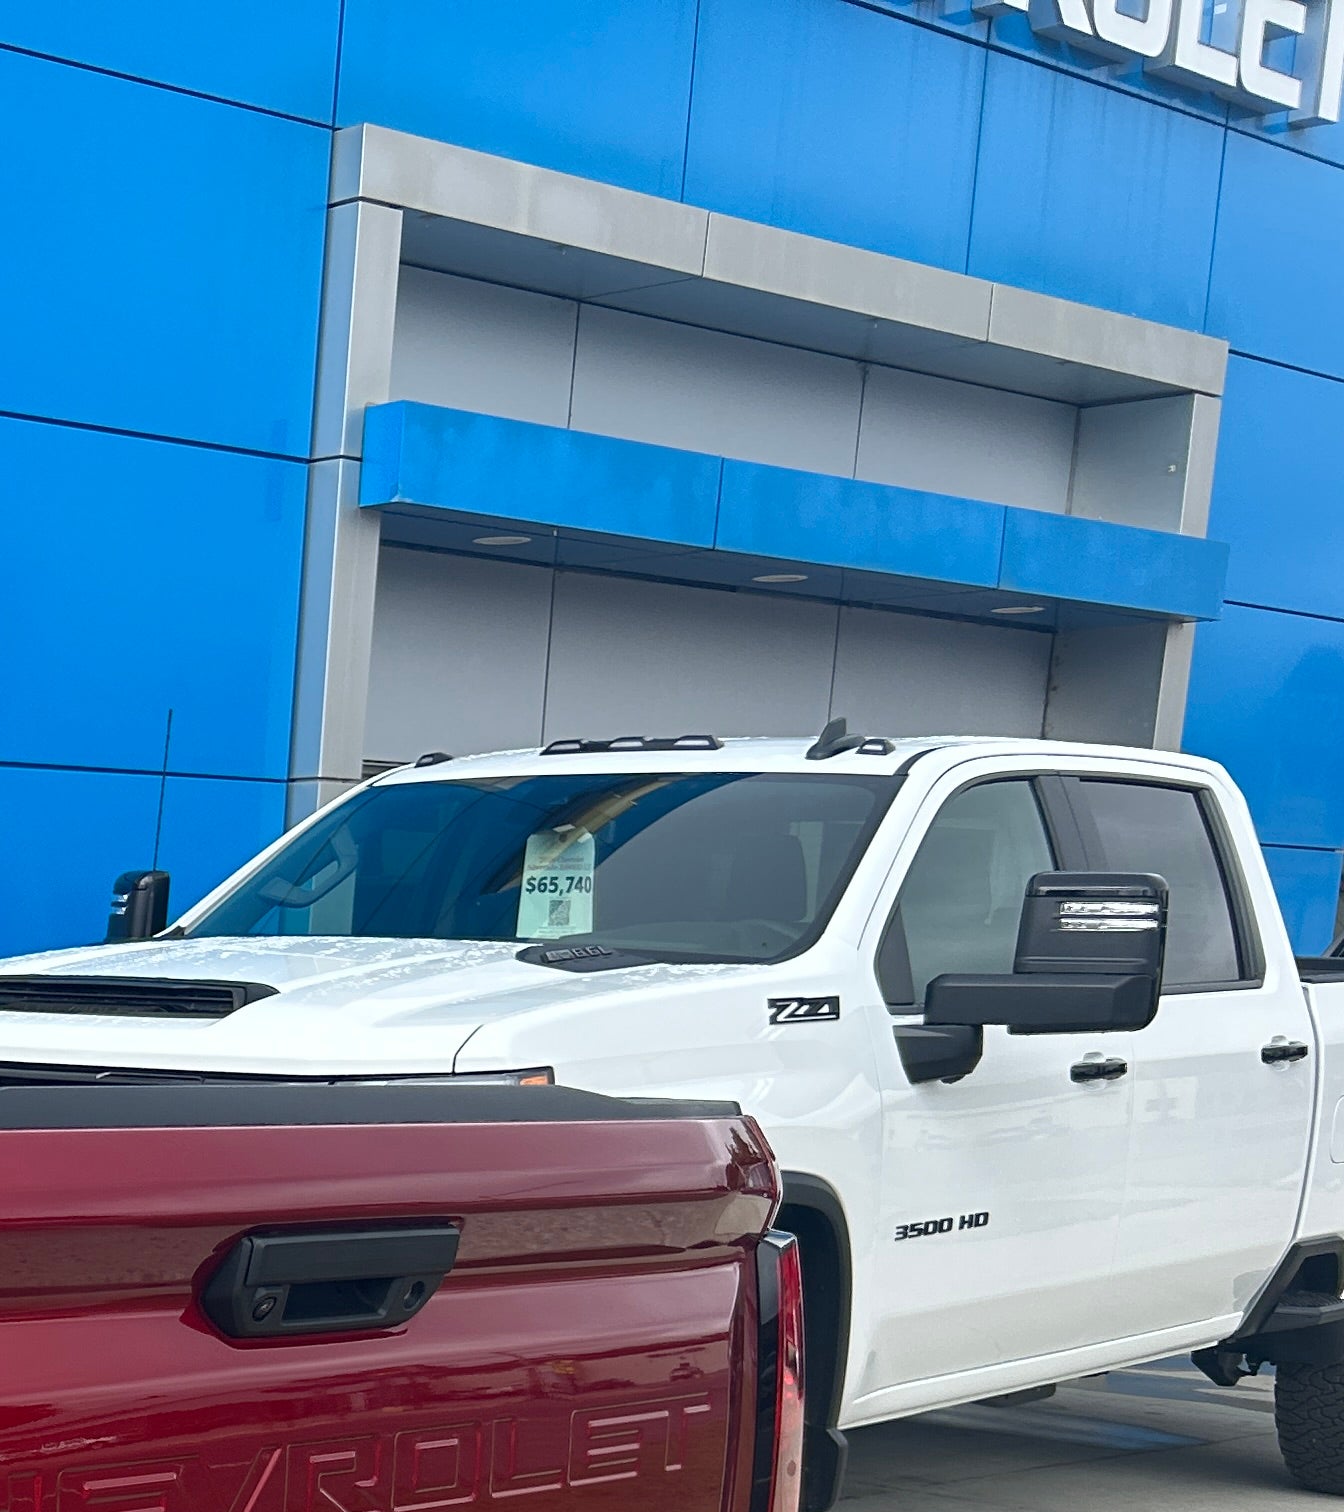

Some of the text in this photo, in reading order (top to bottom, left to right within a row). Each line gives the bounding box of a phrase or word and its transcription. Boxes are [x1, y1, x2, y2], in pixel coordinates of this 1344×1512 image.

[525, 876, 592, 896] $65,740
[894, 1212, 989, 1241] 3500 HD
